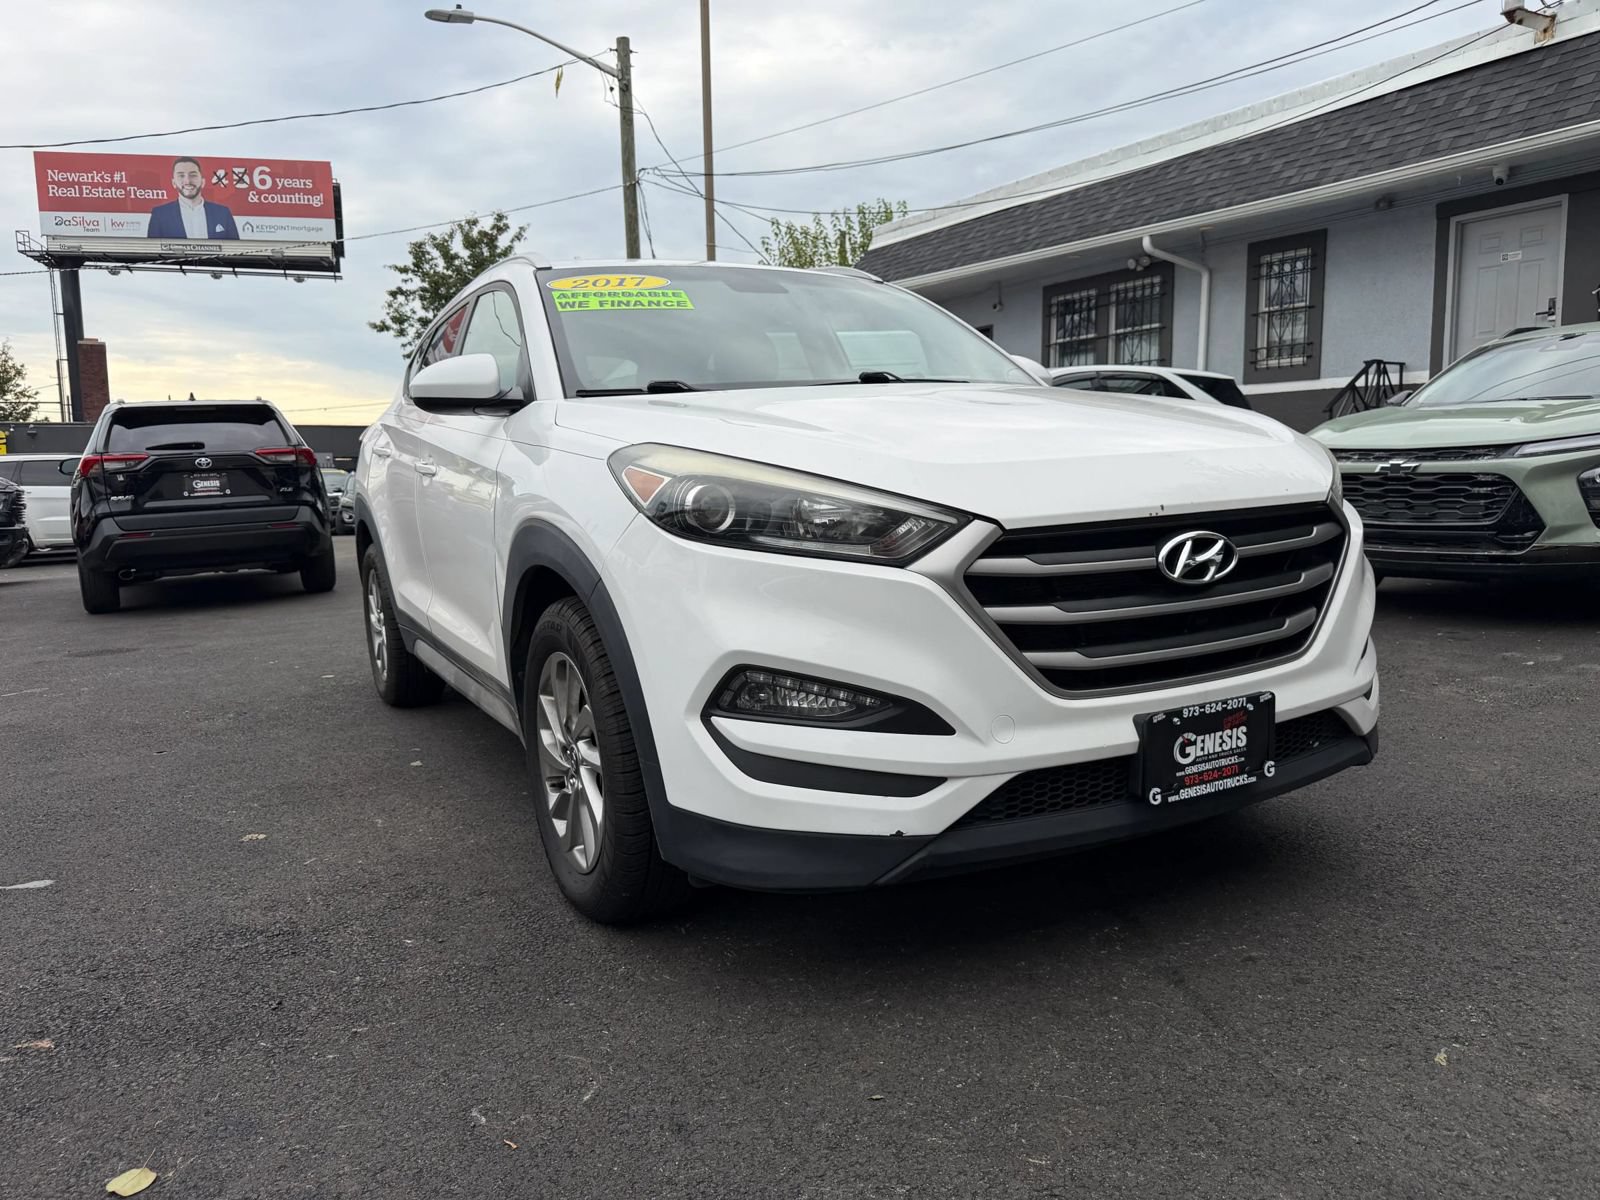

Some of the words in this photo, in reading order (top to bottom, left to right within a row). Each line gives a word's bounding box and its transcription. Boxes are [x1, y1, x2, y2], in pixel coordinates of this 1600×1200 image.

[47, 170, 111, 183] Newark's
[113, 171, 128, 184] #1
[252, 166, 273, 190] 6
[275, 178, 313, 190] years
[48, 185, 80, 197] Real
[82, 186, 125, 198] Estate
[127, 186, 168, 200] Team
[248, 191, 260, 203] &
[261, 193, 323, 207] counting!
[54, 216, 100, 227] DaSilva
[111, 218, 126, 229] kw
[290, 224, 323, 233] mortgage
[571, 276, 647, 289] 2017
[558, 301, 590, 309] WE
[599, 300, 689, 309] FINANCE
[192, 480, 220, 489] GENESIS
[1182, 697, 1247, 718] 973-624-2071
[1173, 726, 1247, 764] GENESIS
[1183, 765, 1239, 786] 973-624-2071
[1264, 760, 1276, 777] G
[1149, 787, 1162, 805] G
